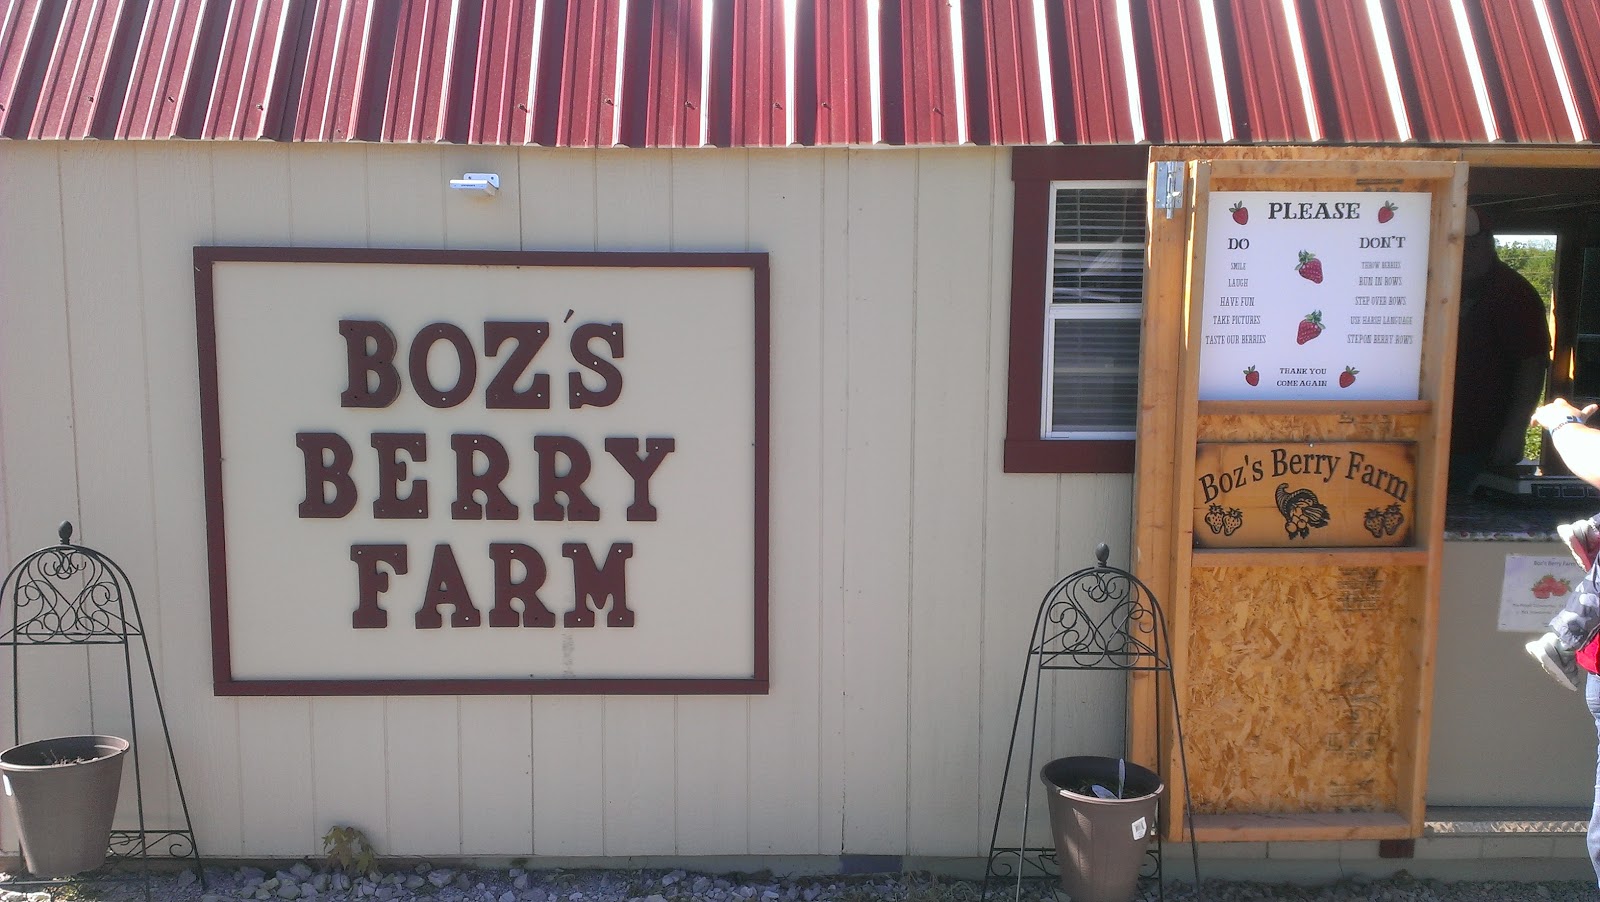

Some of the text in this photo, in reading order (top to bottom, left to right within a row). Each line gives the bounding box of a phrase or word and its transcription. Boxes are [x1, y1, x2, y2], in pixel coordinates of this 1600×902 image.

[1267, 202, 1361, 220] PLEASE
[1227, 237, 1250, 250] DO
[1359, 235, 1406, 249] DON'T
[1230, 262, 1246, 270] SMILE
[1228, 278, 1248, 287] LAUGH
[1358, 276, 1402, 286] RUN IN ROWS
[1219, 296, 1255, 306] HAVE FUN
[1355, 296, 1406, 305] STEP OVER ROWS
[1212, 315, 1261, 325] TAKE PICTURES
[1350, 316, 1413, 324] USE HARSH LANGUAGE
[1205, 334, 1267, 345] TASTE OUR BERRIES
[1373, 334, 1394, 344] BERRY
[1395, 335, 1413, 344] ROWS
[339, 309, 624, 409] BOZ'S
[295, 432, 676, 521] BERRY
[1198, 447, 1410, 504] Boz's Berry Farm
[350, 542, 635, 629] FARM
